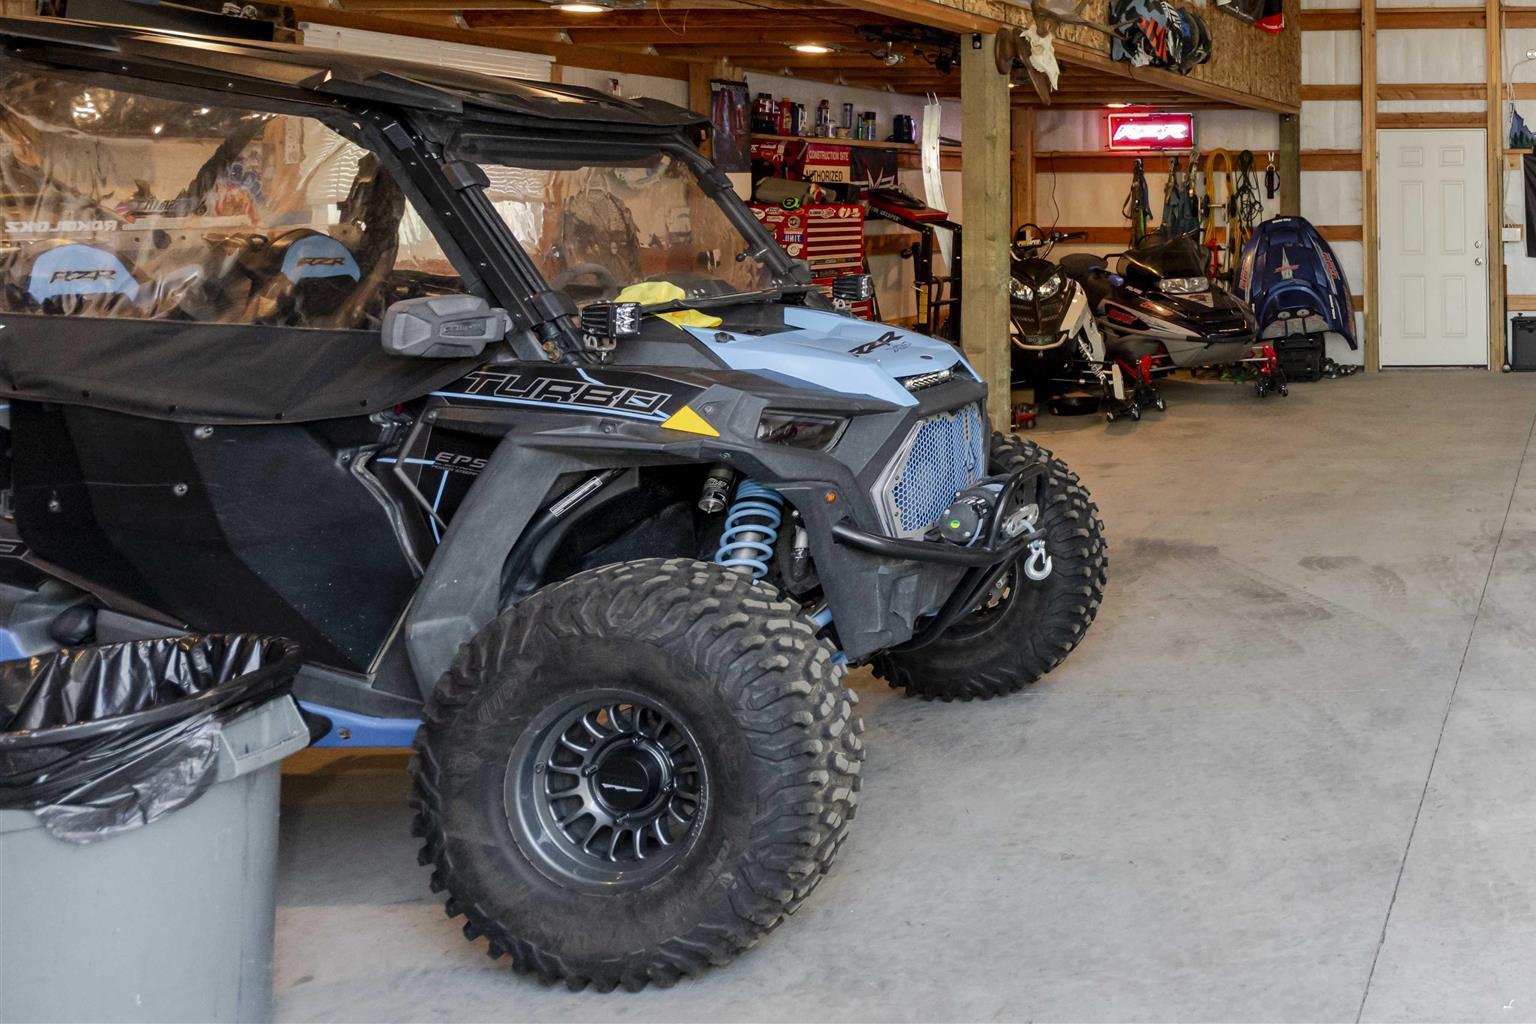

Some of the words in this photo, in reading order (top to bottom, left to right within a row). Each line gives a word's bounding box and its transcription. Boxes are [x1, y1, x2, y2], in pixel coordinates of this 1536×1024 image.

[1112, 124, 1188, 141] RZR
[808, 150, 838, 160] CONSTRUCTION
[839, 151, 849, 161] SITE
[462, 370, 672, 415] TURBO
[435, 452, 488, 469] EPS
